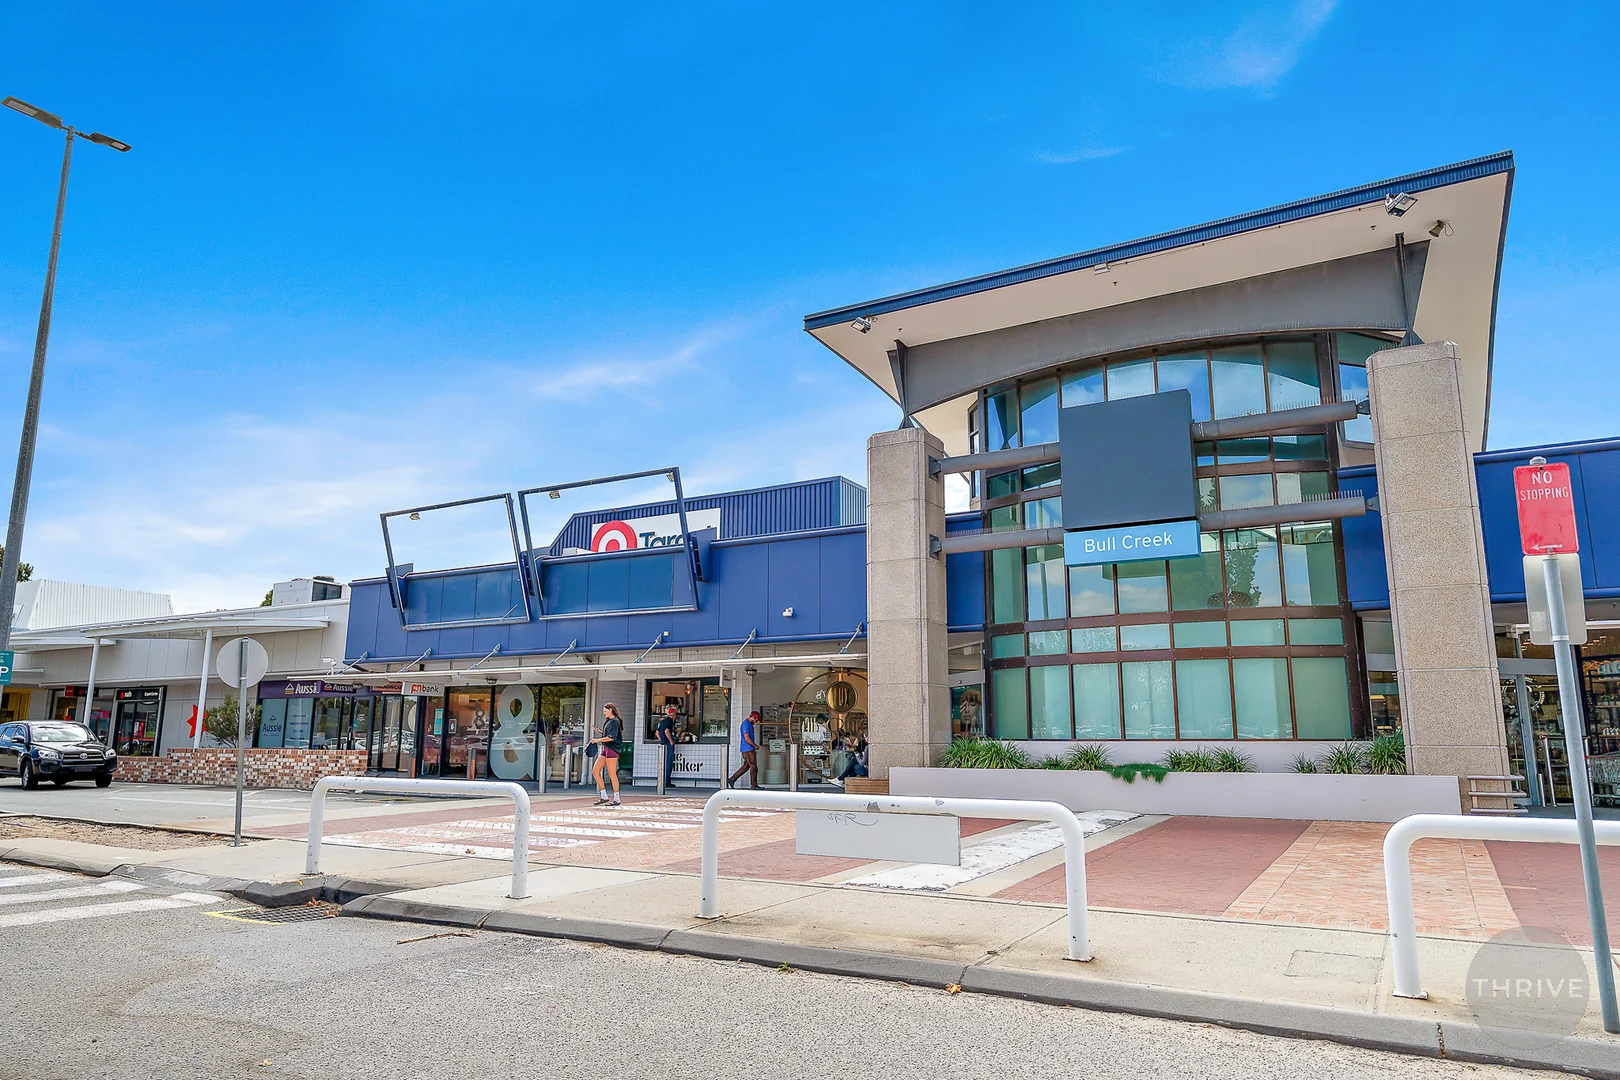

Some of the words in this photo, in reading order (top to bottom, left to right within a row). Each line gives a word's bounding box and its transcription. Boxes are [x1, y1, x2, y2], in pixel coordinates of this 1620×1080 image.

[1531, 471, 1553, 485] NO
[1519, 486, 1569, 501] STOPPING
[1084, 536, 1116, 553] Bull
[1121, 531, 1174, 550] Creek
[295, 682, 319, 695] Aussi
[332, 684, 354, 693] Aussie
[422, 684, 439, 693] bank
[262, 722, 282, 732] Aussie
